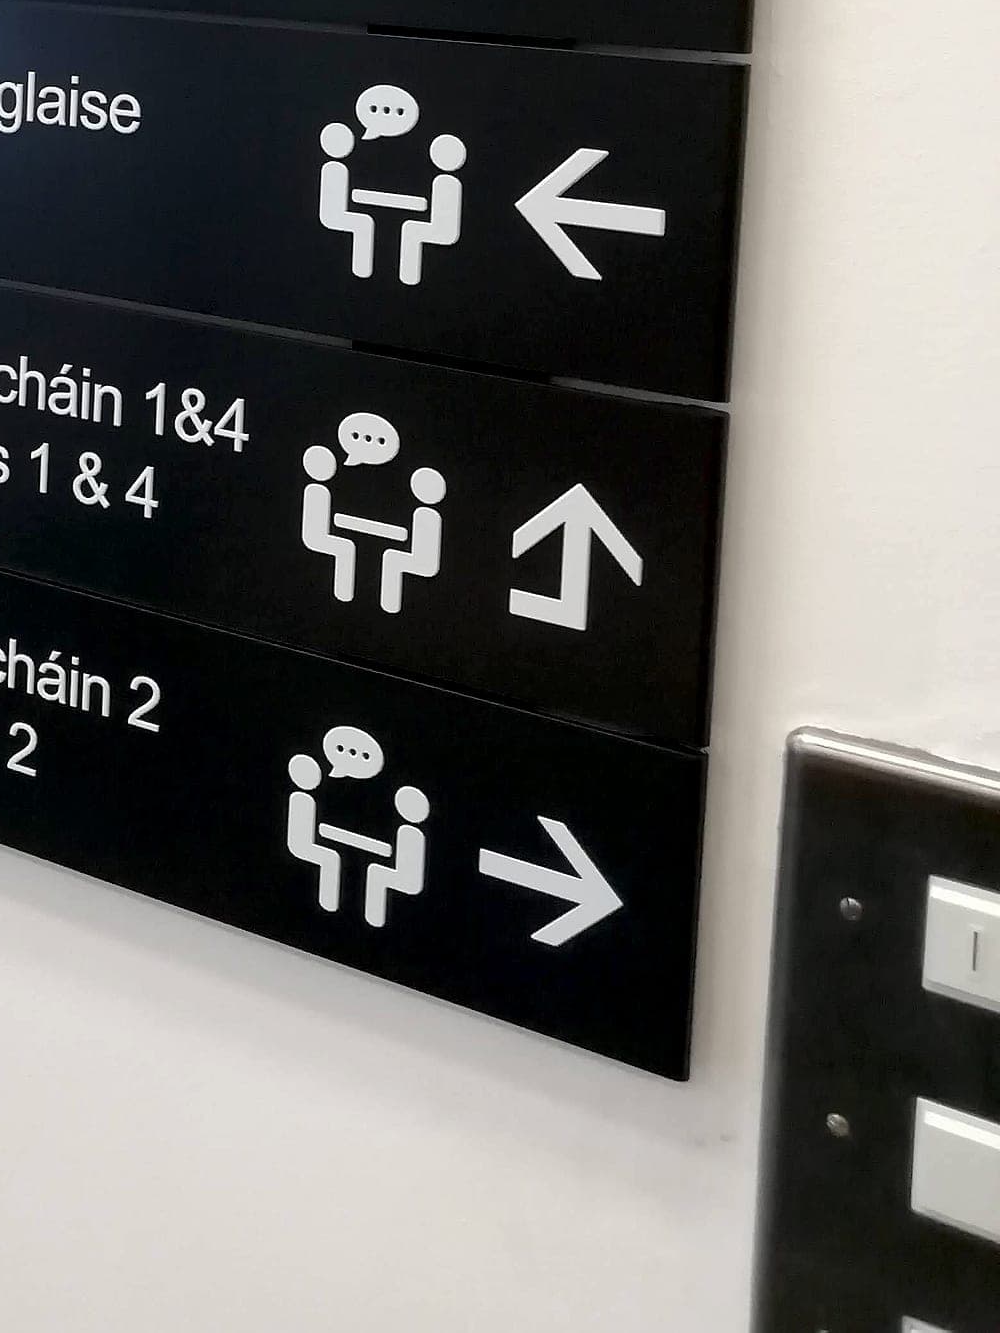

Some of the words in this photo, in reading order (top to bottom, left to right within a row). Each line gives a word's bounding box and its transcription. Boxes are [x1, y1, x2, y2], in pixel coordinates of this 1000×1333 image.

[146, 382, 250, 453] 1&4
[30, 442, 49, 494] 1
[72, 452, 111, 509] &
[125, 466, 159, 519] 4
[127, 676, 161, 733] 2
[6, 722, 38, 777] 2
